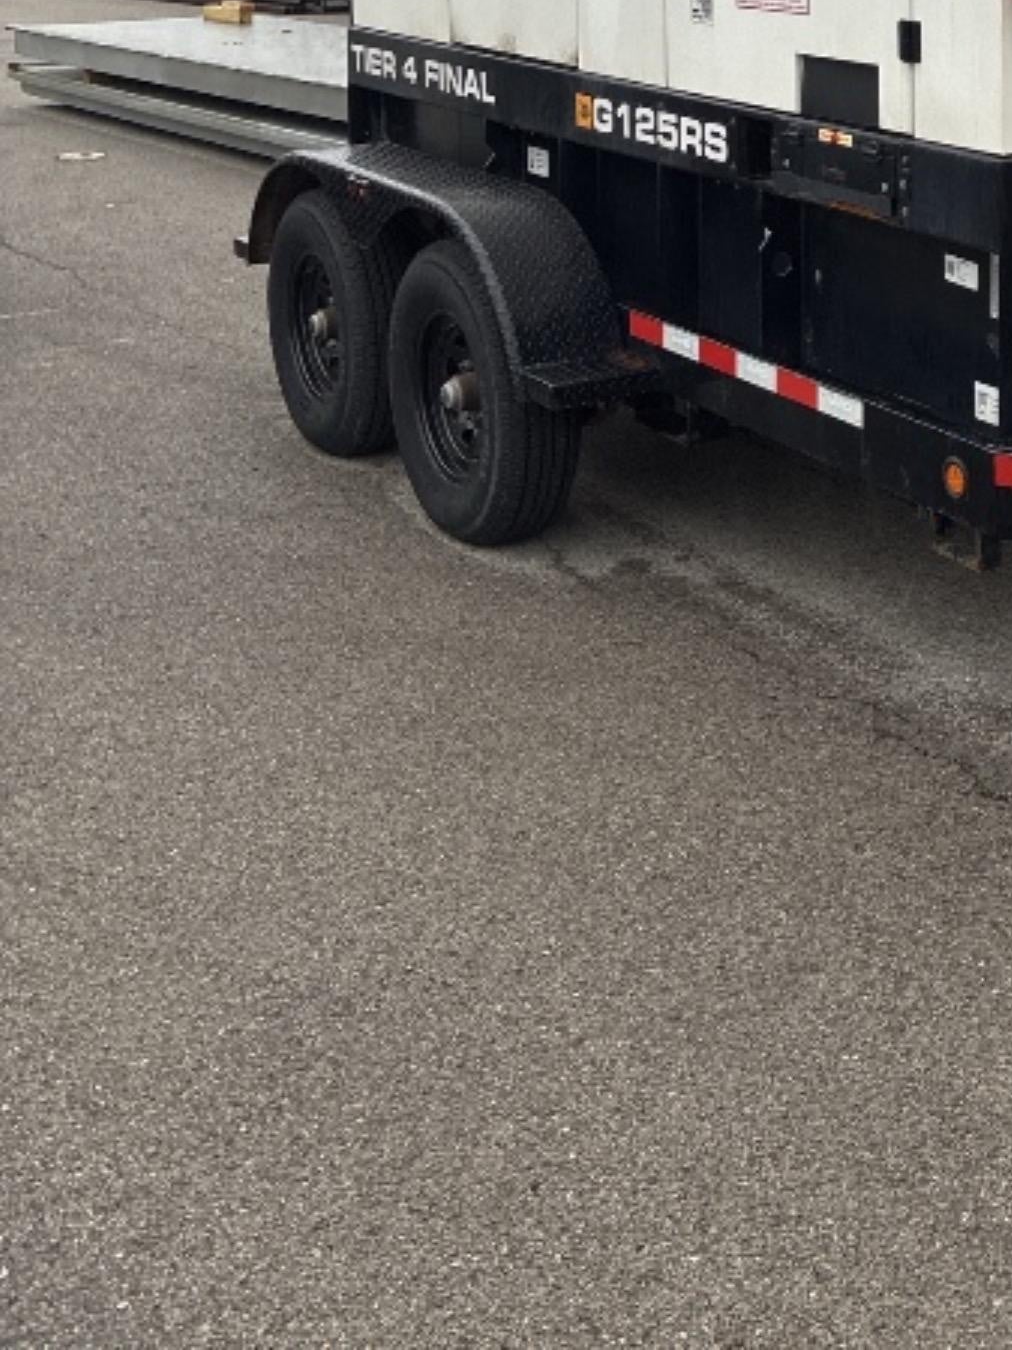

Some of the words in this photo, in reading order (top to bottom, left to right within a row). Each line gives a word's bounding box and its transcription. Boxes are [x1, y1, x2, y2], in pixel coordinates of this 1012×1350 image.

[351, 44, 397, 83] TIER
[400, 56, 418, 85] 4
[424, 58, 496, 105] FINAL
[593, 97, 728, 163] G125RS
